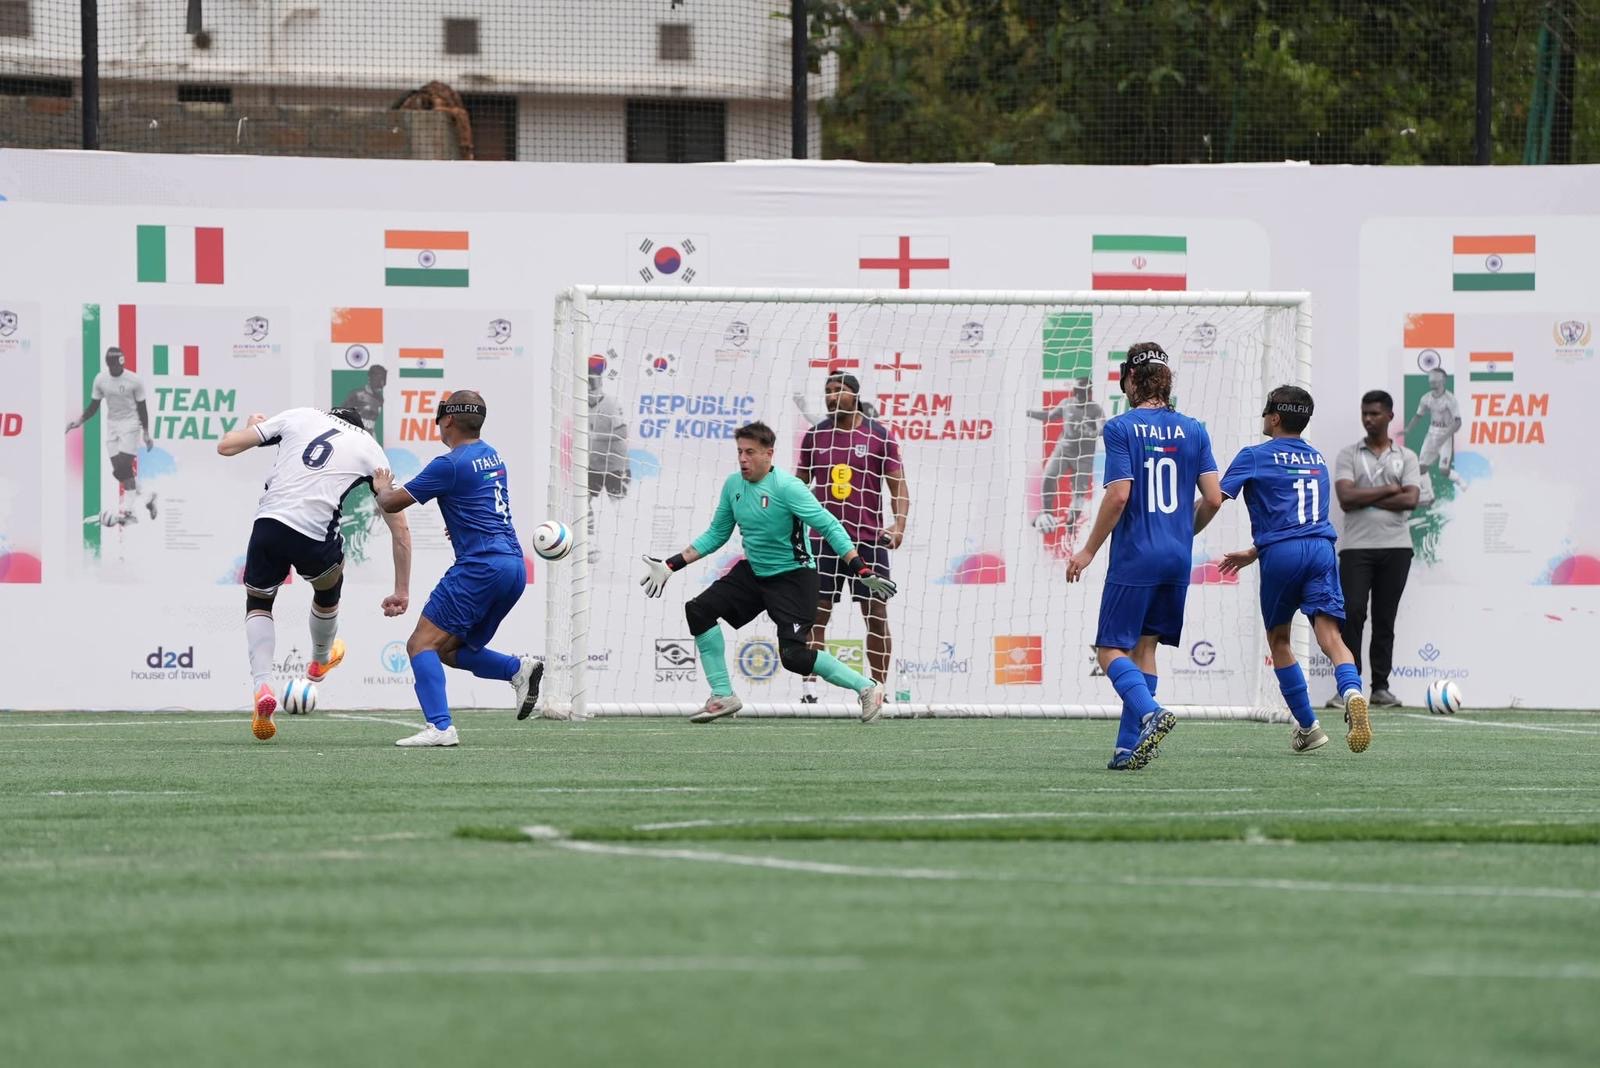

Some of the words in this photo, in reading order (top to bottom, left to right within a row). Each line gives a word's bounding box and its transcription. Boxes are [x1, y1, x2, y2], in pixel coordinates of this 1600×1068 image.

[1132, 349, 1168, 365] GOALFI
[154, 388, 237, 412] TEAM
[445, 403, 479, 414] GOALFIX
[638, 395, 755, 416] REPUBLIC
[877, 393, 953, 417] TEAM
[1276, 402, 1310, 415] GOALFIX
[1470, 393, 1549, 417] TEAM
[153, 416, 239, 440] ITALY
[638, 418, 670, 439] OF
[673, 419, 752, 440] KORE
[879, 418, 993, 441] NGLAND
[1133, 423, 1186, 441] ITALIA
[1469, 420, 1546, 445] INDIA
[302, 428, 344, 471] 6
[1273, 452, 1327, 466] ITALIA
[1143, 457, 1178, 514] 10
[1293, 477, 1320, 525] 11
[146, 646, 194, 669] d2d
[896, 658, 927, 673] New
[131, 669, 166, 680] house
[167, 669, 179, 680] of
[181, 669, 211, 680] travel
[364, 676, 404, 684] HEALING
[655, 671, 697, 683] SRVC
